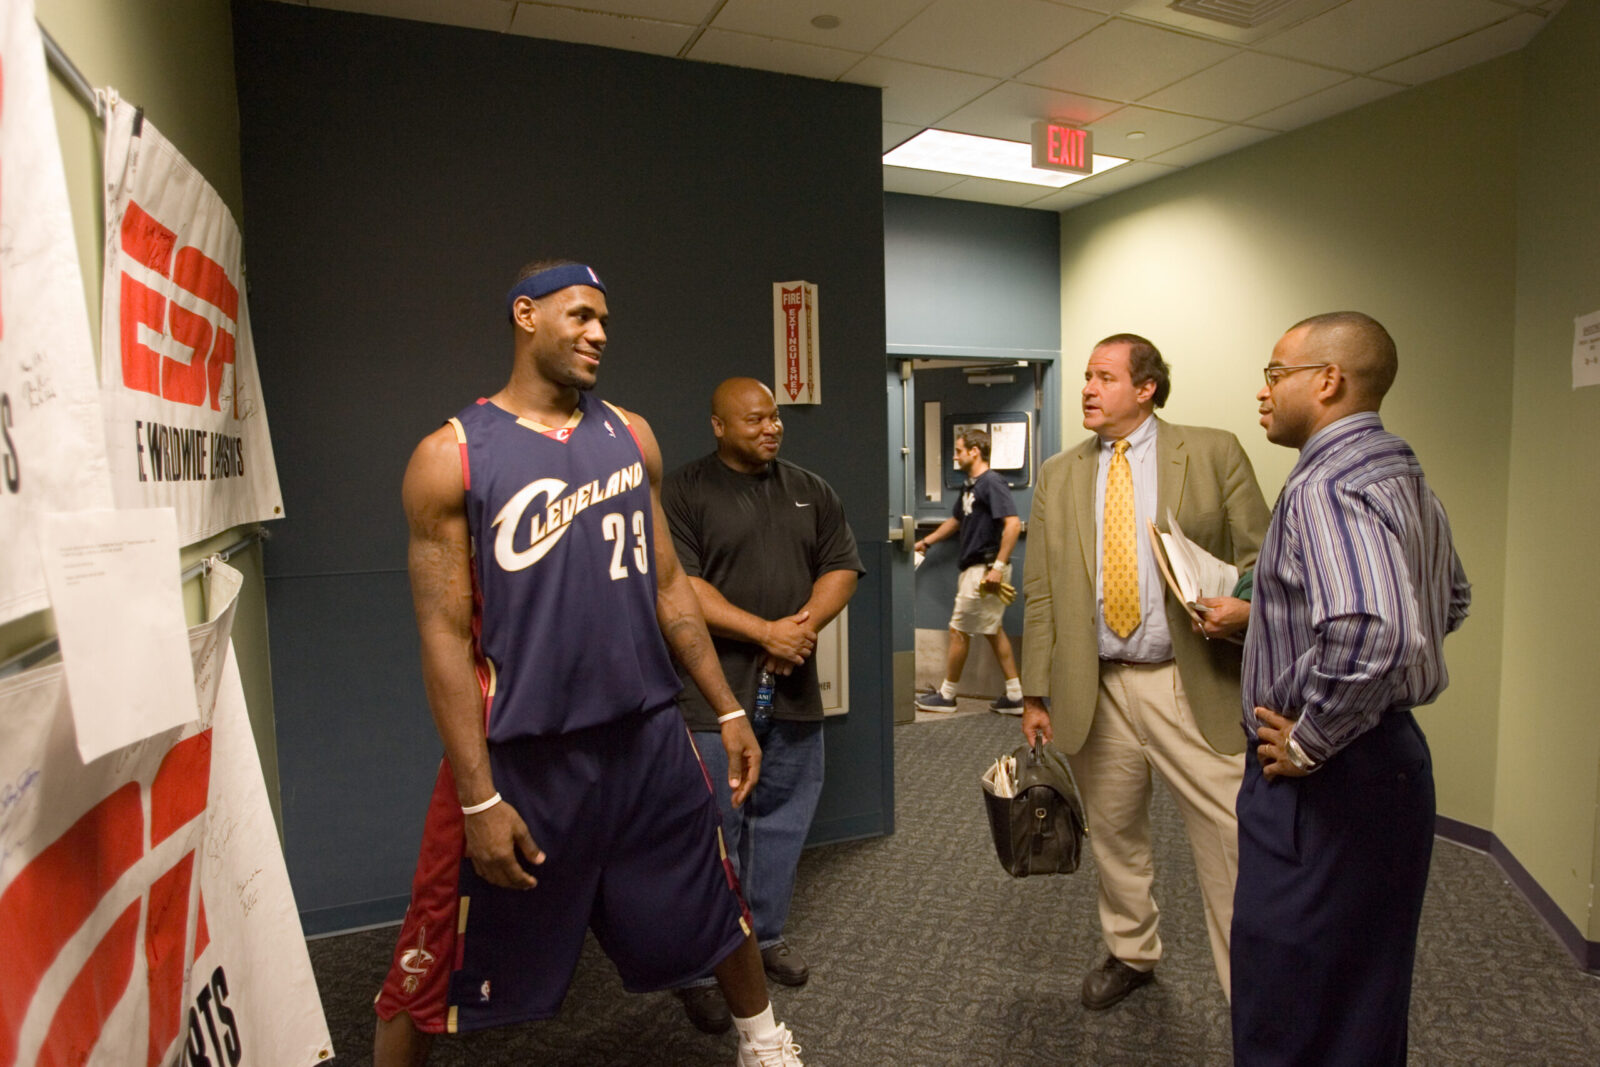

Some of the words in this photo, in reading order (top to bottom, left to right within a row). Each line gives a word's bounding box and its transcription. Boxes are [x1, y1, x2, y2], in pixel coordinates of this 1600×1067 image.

[1047, 124, 1087, 169] EXIT
[783, 293, 801, 305] FIRE
[788, 308, 798, 396] EXTINGUISHER
[491, 461, 644, 572] CLEVELAND
[601, 510, 649, 581] 23
